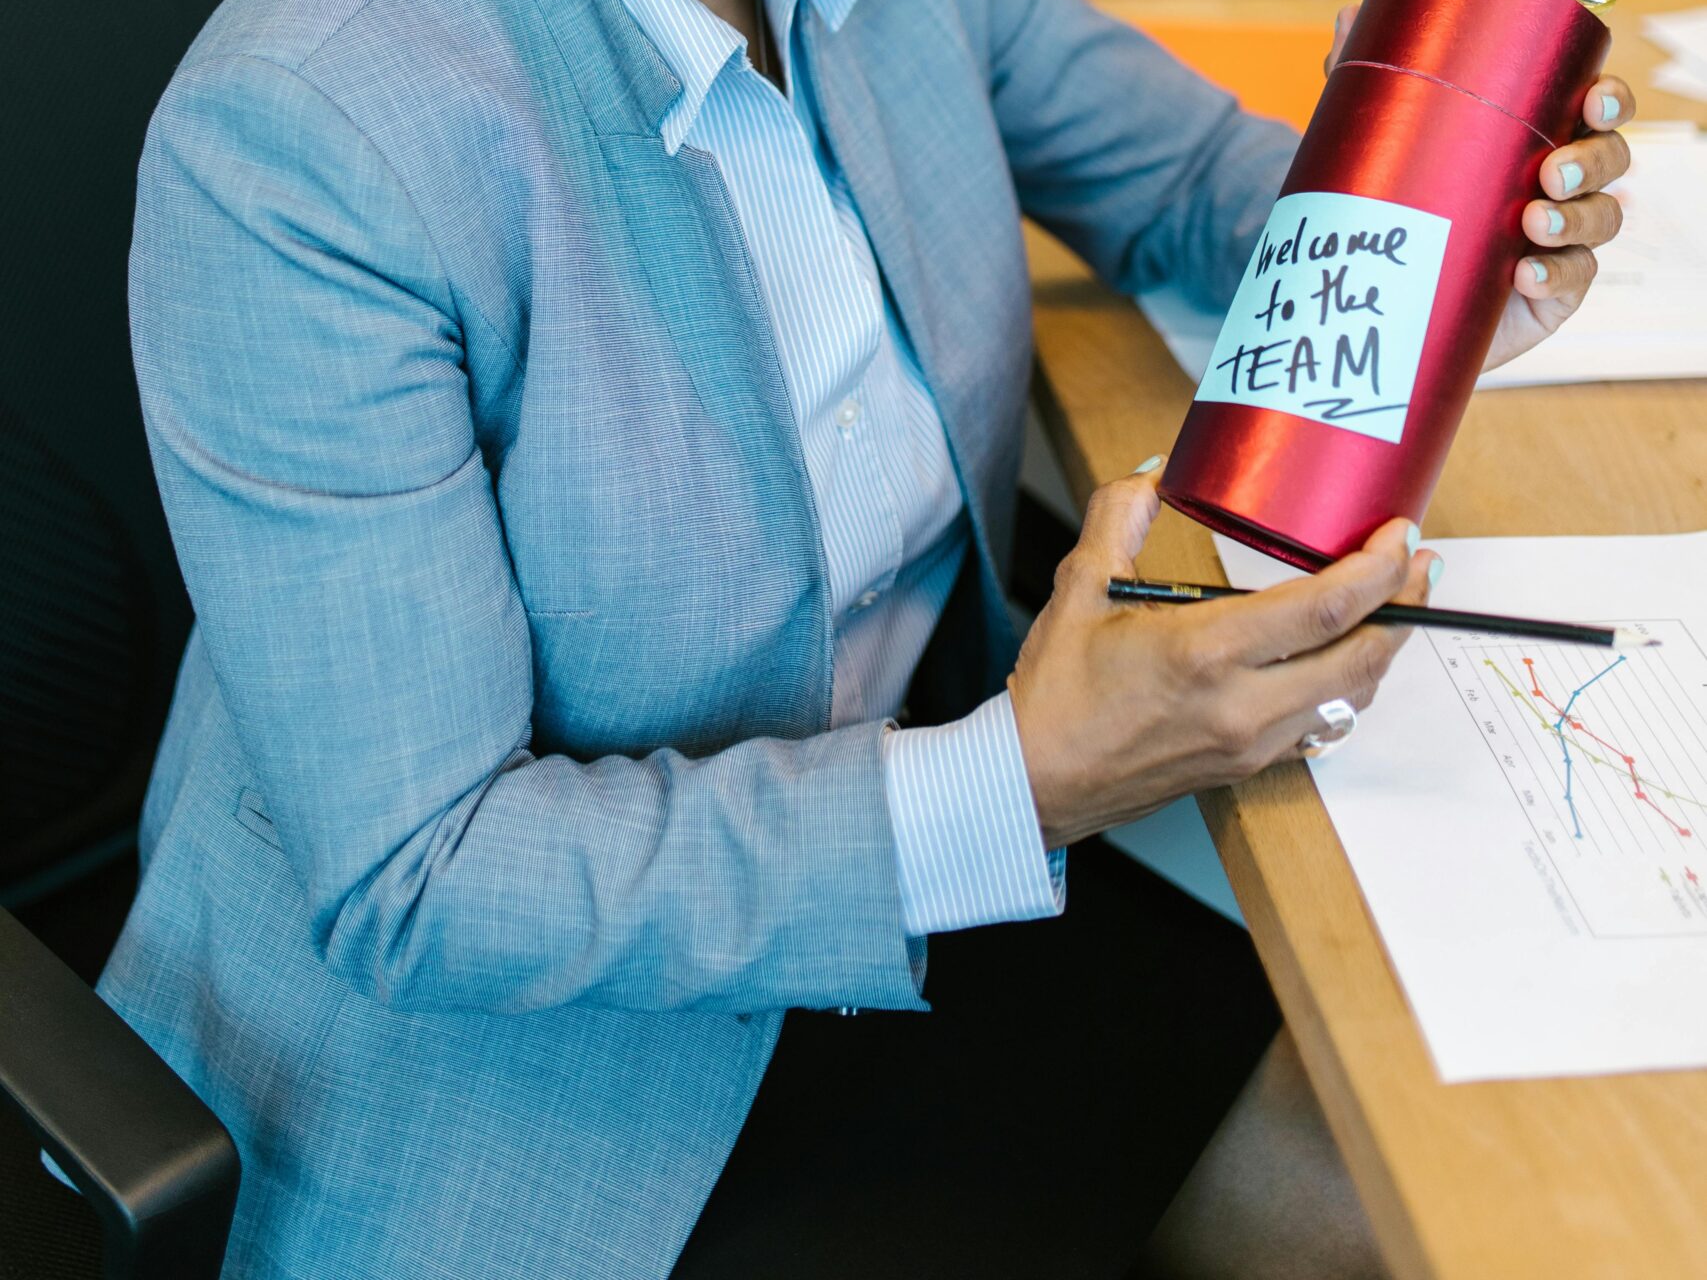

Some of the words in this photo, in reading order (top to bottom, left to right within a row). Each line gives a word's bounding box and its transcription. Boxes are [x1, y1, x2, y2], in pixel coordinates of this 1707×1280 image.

[1255, 279, 1295, 332] to
[1311, 265, 1384, 326] the
[1216, 326, 1381, 396] TEAM
[1171, 583, 1202, 599] Black
[1447, 657, 1459, 669] Jan
[1464, 688, 1480, 702] Feb
